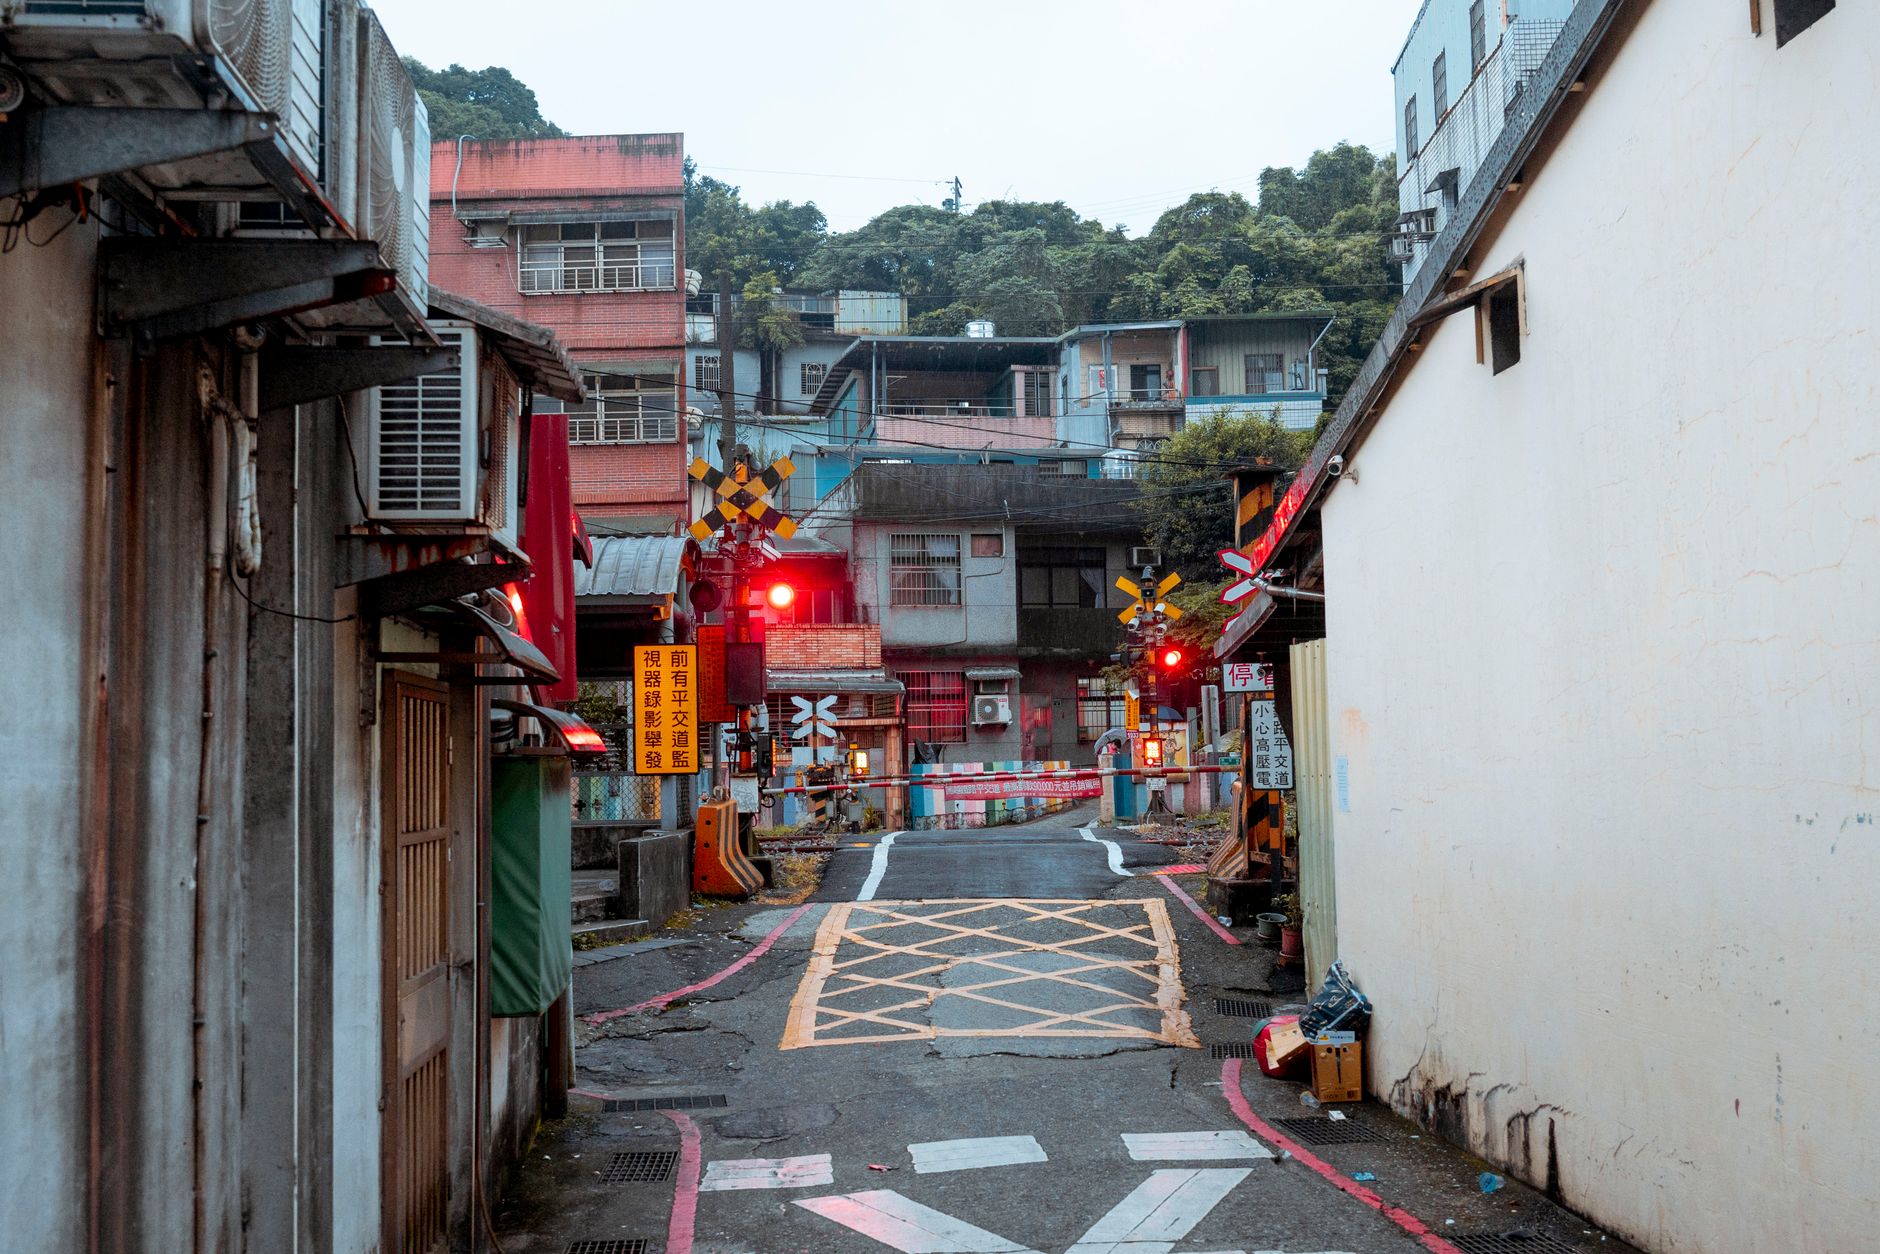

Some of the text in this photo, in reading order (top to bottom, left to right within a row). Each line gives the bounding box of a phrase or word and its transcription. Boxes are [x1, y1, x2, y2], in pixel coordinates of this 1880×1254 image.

[644, 650, 662, 769] 視器錄影舉發
[671, 650, 689, 769] 前有平交道監
[1255, 704, 1271, 786] 小心高壓電
[1273, 702, 1289, 786] 路平交道
